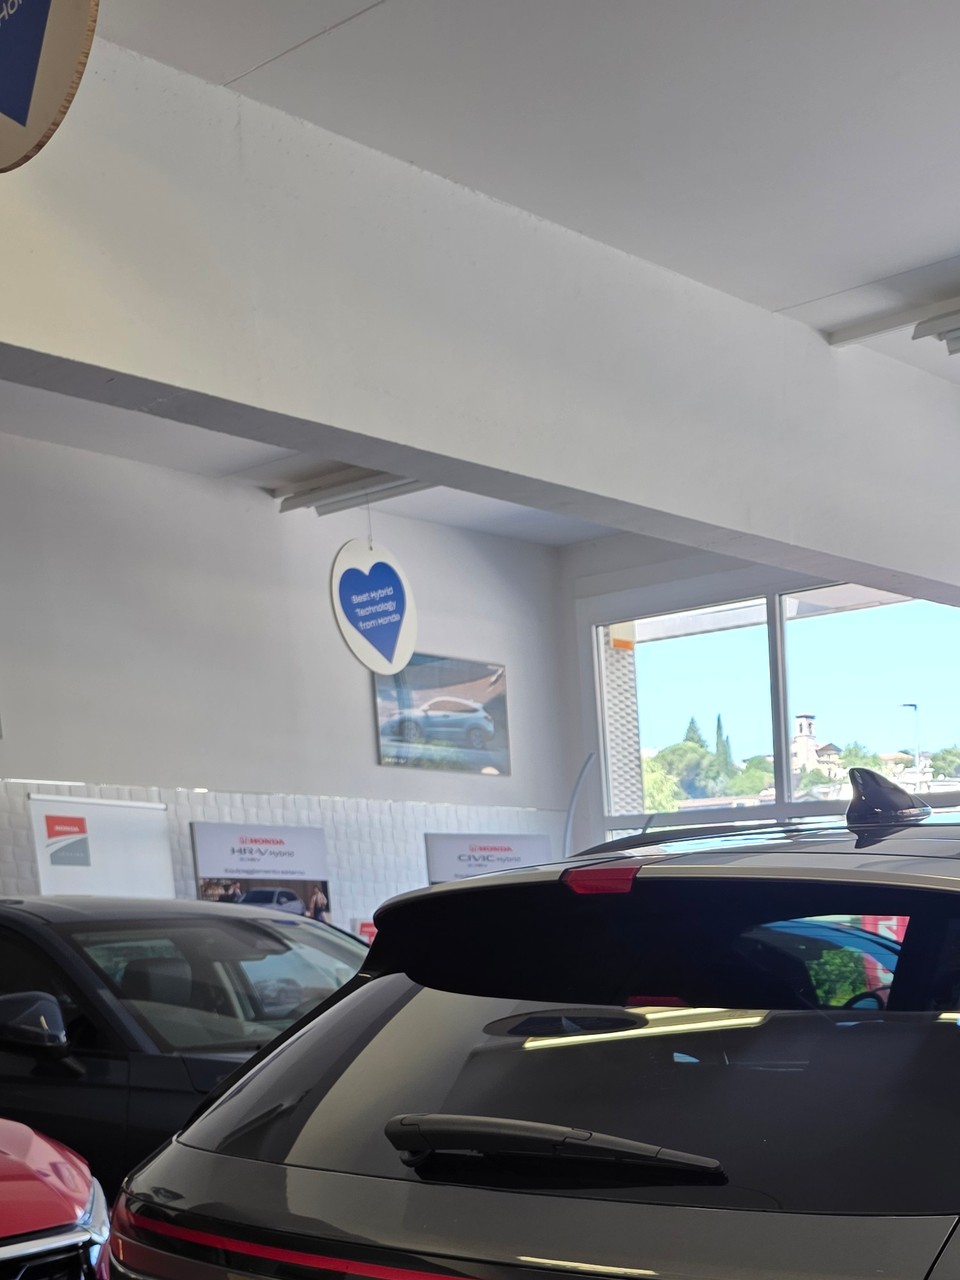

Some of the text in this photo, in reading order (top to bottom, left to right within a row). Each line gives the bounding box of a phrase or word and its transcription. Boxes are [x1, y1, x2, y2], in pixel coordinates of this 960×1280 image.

[352, 586, 394, 604] Best Hybrid
[355, 601, 396, 616] Technology
[359, 614, 400, 630] from Honda
[250, 838, 285, 846] HONDA
[457, 854, 495, 862] CIVIC
